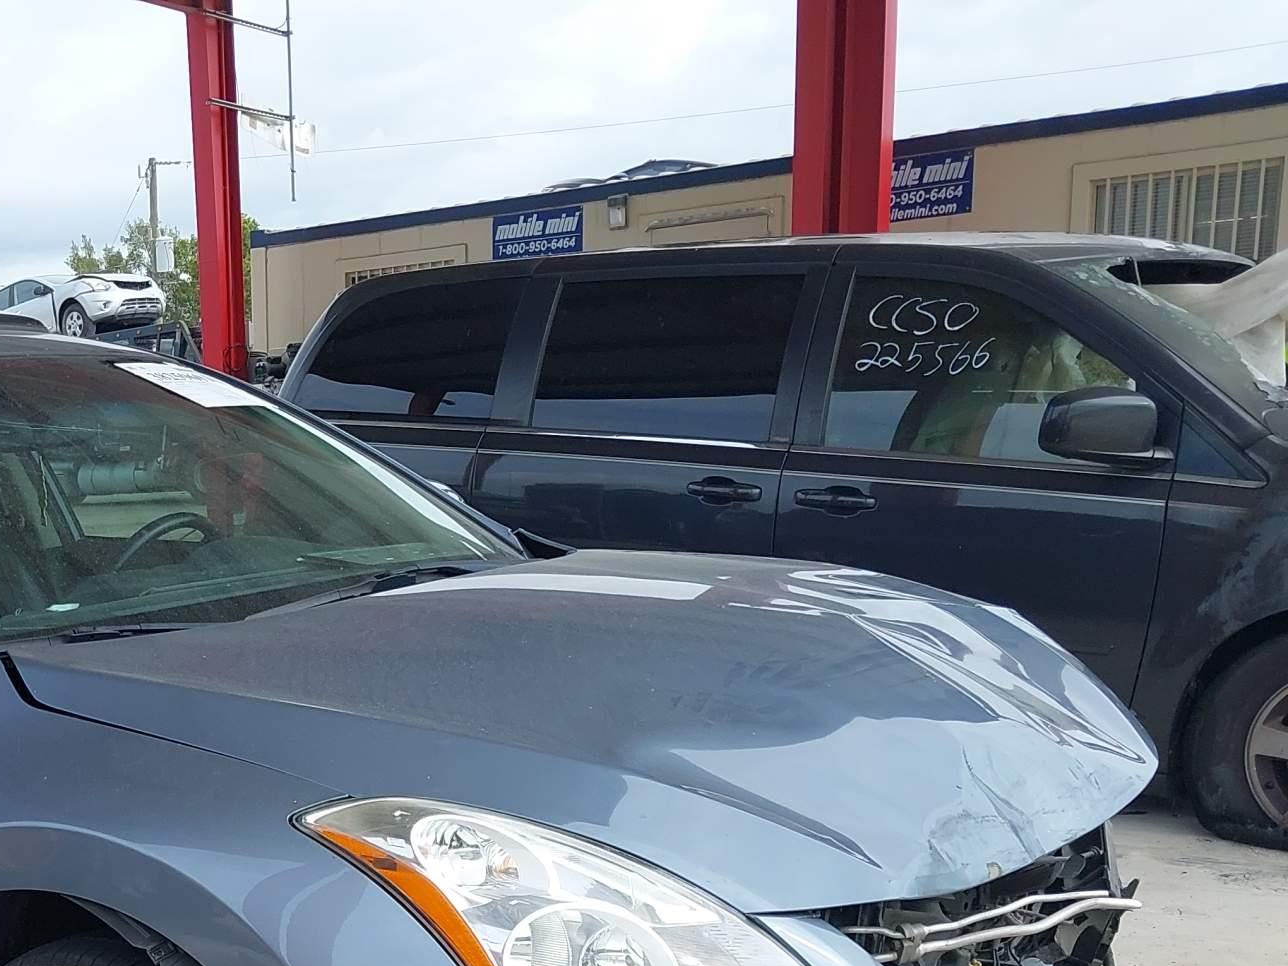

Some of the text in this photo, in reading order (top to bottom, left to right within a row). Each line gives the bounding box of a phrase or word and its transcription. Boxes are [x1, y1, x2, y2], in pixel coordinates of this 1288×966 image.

[922, 155, 970, 183] mini
[495, 211, 580, 240] mobile mini
[499, 236, 576, 257] 1-800-950-6464
[855, 337, 997, 377] 225566
